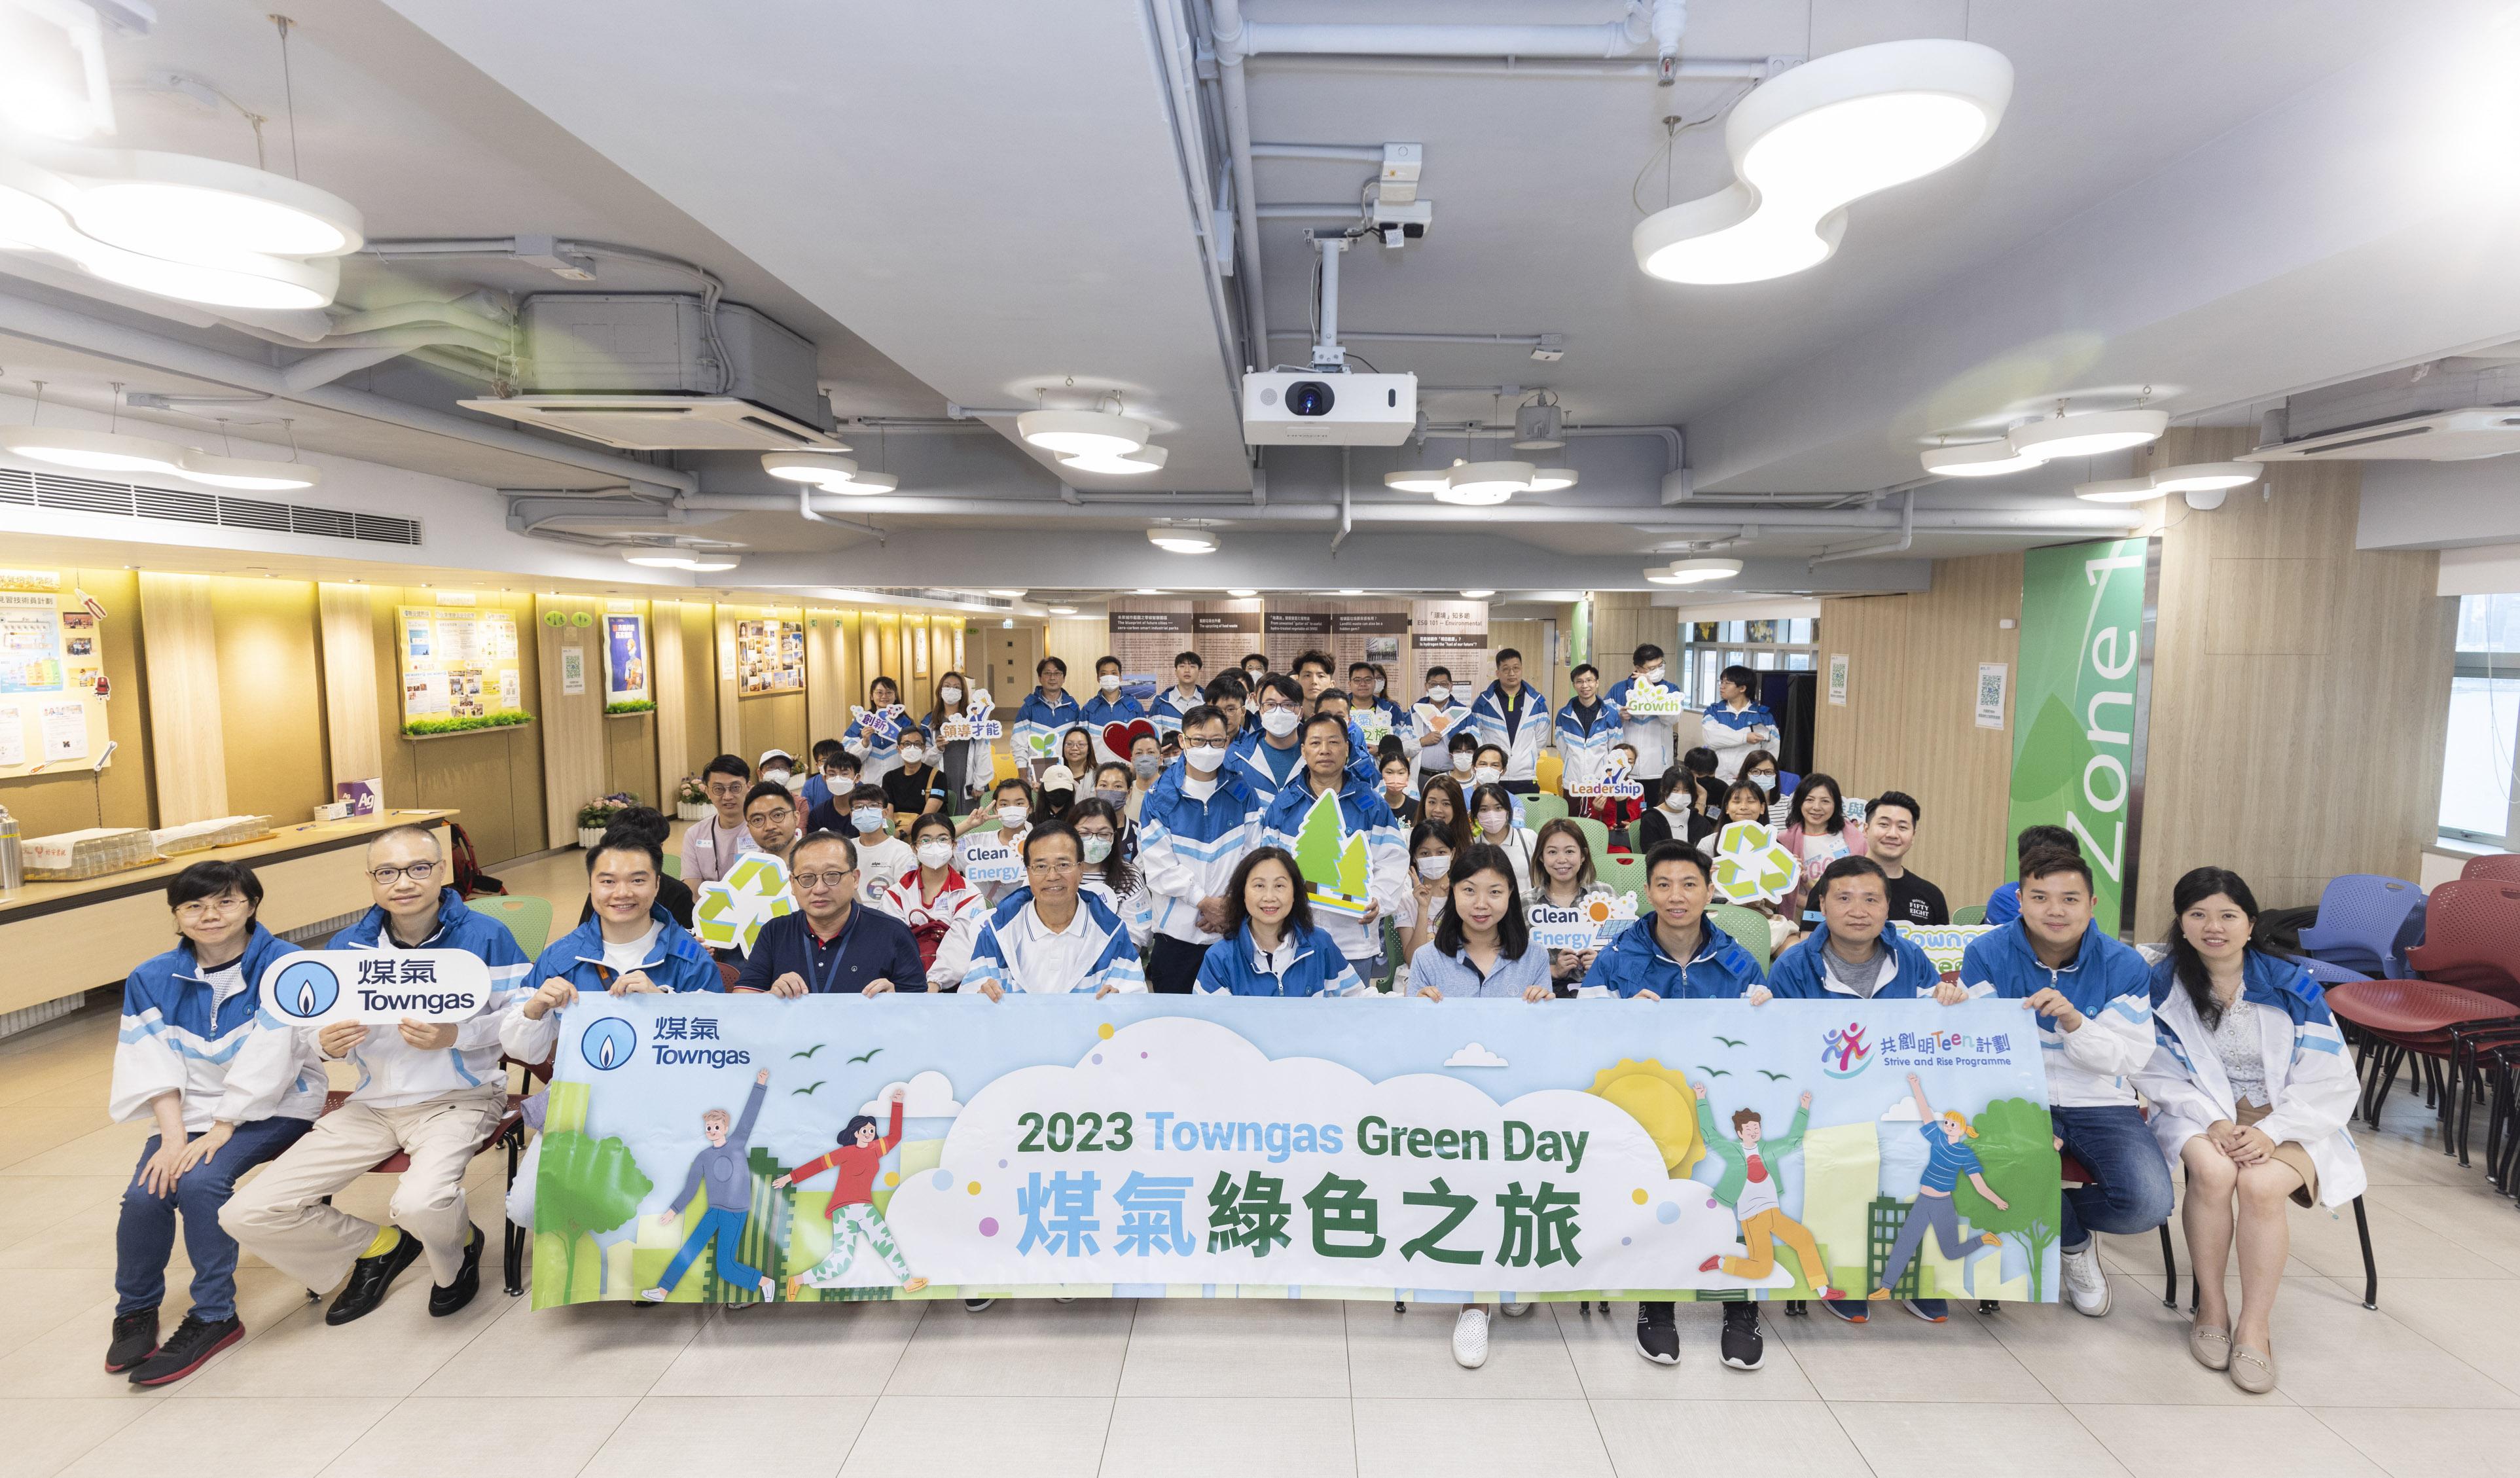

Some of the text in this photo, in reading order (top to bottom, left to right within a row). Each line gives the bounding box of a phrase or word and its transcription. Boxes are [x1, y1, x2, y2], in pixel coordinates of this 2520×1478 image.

[2085, 554, 2142, 586] 1
[1629, 700, 1678, 712] Growth
[861, 713, 886, 731] 創新
[943, 722, 1000, 738] 領導才能
[1572, 782, 1641, 796] Leadership
[358, 793, 374, 809] Ag
[967, 846, 1009, 861] Clean
[968, 867, 1020, 880] Energy
[1909, 902, 1929, 910] FIFTY
[1910, 908, 1930, 916] EIGHT
[1532, 908, 1579, 924] Clean
[1533, 931, 1592, 949] Energy
[358, 959, 437, 986] 煤氣
[357, 990, 475, 1014] Towngas
[653, 1017, 720, 1041] 煤氣
[652, 1045, 750, 1069] Towngas
[1884, 1057, 2011, 1068] Strive and Rise Programme
[1017, 1111, 1589, 1173] 2023 Towngas Green Day
[1016, 1170, 1582, 1269] 煤氣綠色之旅
